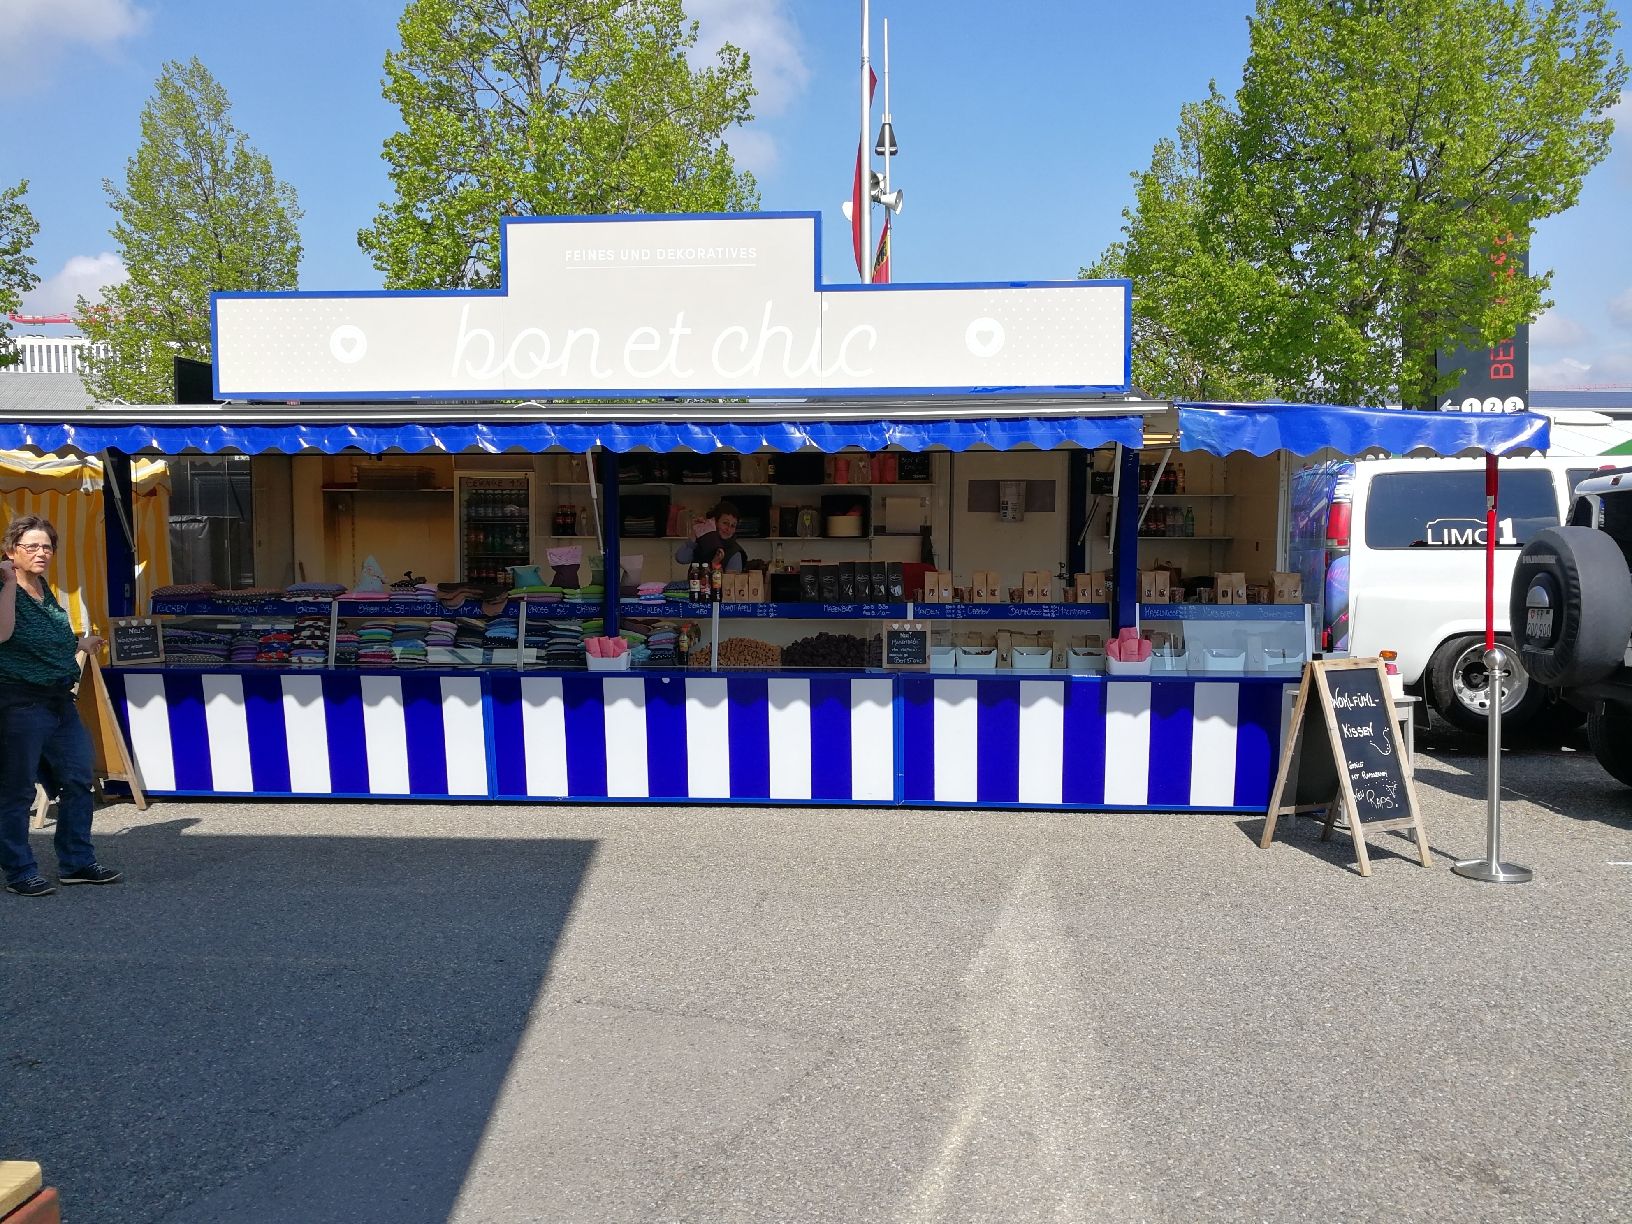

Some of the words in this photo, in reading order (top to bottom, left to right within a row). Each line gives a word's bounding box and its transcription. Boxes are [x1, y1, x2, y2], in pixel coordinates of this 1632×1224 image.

[565, 248, 615, 262] FEINES
[620, 248, 651, 261] UND
[656, 246, 758, 261] DEKORATIVES
[450, 304, 616, 379] bon
[623, 311, 694, 379] et
[711, 300, 878, 378] chic
